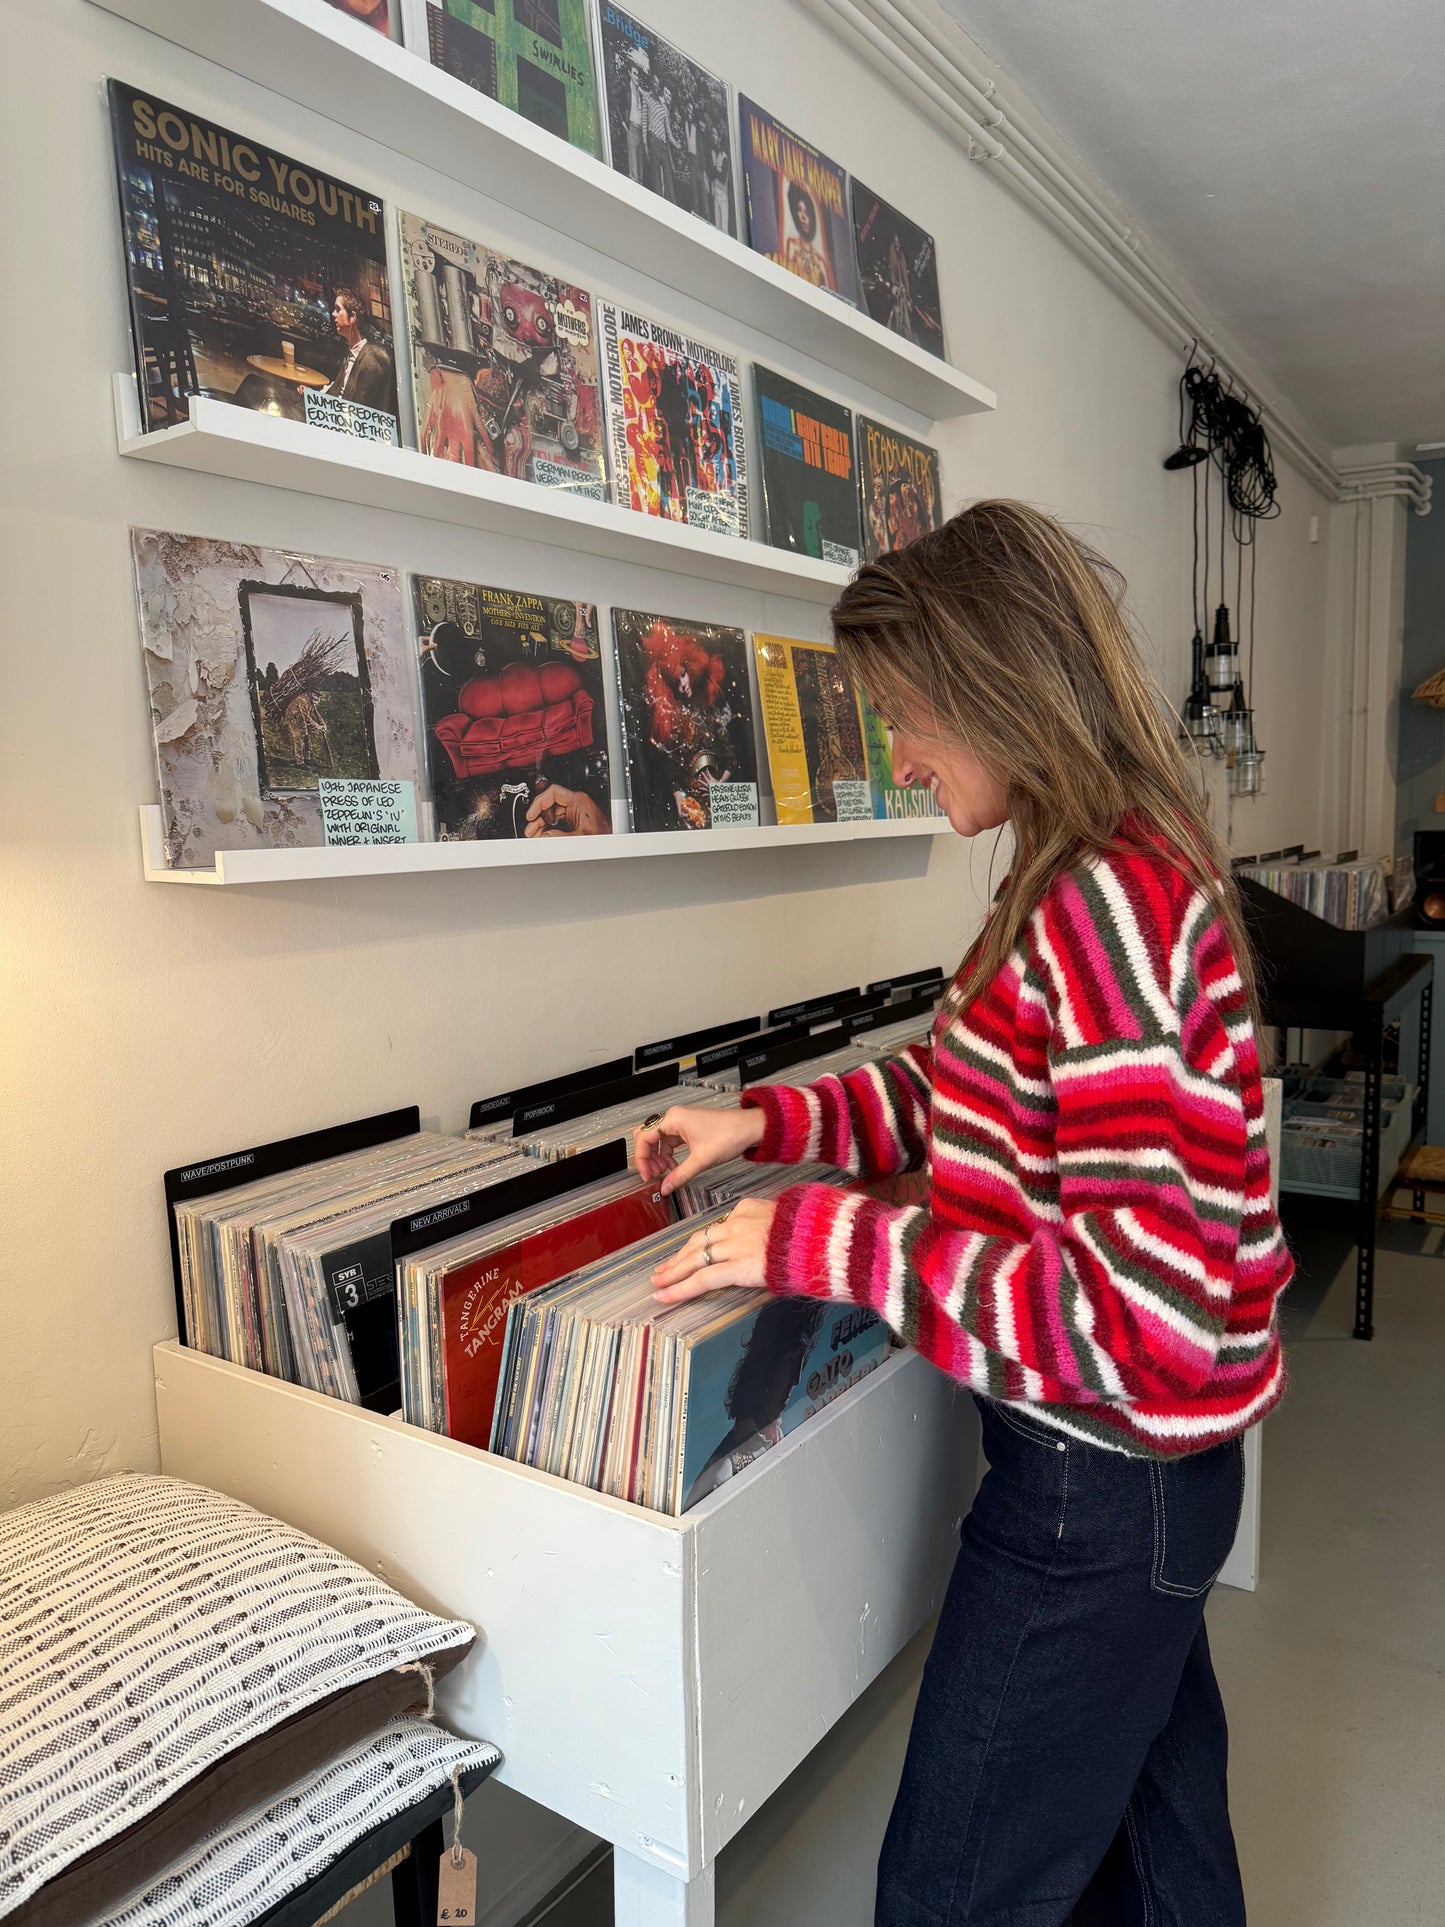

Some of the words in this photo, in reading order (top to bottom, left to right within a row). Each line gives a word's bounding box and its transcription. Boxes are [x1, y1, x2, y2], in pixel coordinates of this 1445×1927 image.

[607, 7, 649, 49] Bridge
[532, 40, 585, 87] SWIRLIES
[132, 99, 261, 182] SONIC
[267, 157, 377, 235] YOUTH
[136, 139, 174, 167] HITS
[178, 157, 209, 183] ARE
[214, 172, 246, 198] FOR
[249, 186, 316, 226] SQUARES
[428, 233, 464, 256] STEREO
[604, 303, 623, 405] MOTHERLODE
[621, 311, 649, 339] JAMES
[651, 324, 685, 354] BROWN:
[686, 339, 738, 377] MOTHERLODE
[307, 393, 372, 421] NUMBERED
[372, 411, 396, 428] FIRST
[728, 379, 742, 423] JAMES
[307, 407, 353, 428] EDITION
[354, 420, 368, 434] OF
[369, 425, 392, 441] THIS
[733, 425, 746, 481] BROWN:
[536, 460, 571, 478] GERMAN
[737, 483, 749, 540] MOTHER
[482, 590, 514, 606] FRANK
[516, 595, 544, 610] ZAPPA
[483, 606, 511, 618] MOTHERS
[504, 620, 516, 628] SIZE
[321, 781, 345, 794] 1976
[347, 782, 402, 794] JAPANESE
[711, 783, 735, 795] PRISTINE
[711, 794, 730, 804] HEAVY
[322, 795, 358, 807] PRESS
[362, 795, 374, 806] OF
[376, 796, 394, 807] LED
[712, 803, 739, 814] GATEFOLD
[324, 808, 383, 821] ZEPPELIN'S
[327, 822, 352, 833] WITH
[354, 822, 401, 833] ORIGINAL
[328, 835, 361, 846] INNER
[372, 835, 407, 845] INSERT
[481, 1096, 511, 1112] SHOEGAZE
[524, 1104, 555, 1120] POP/ROCK
[182, 1155, 252, 1180] WAVE/POSTPUNK
[412, 1214, 431, 1230] NEW
[432, 1201, 469, 1221] ARRIVALS
[338, 1268, 357, 1281] SYR
[345, 1283, 359, 1307] 3
[460, 1268, 500, 1342] TANGERINE
[464, 1280, 524, 1359] TANGRAM
[806, 1349, 854, 1401] GATO
[454, 1908, 468, 1918] 20
